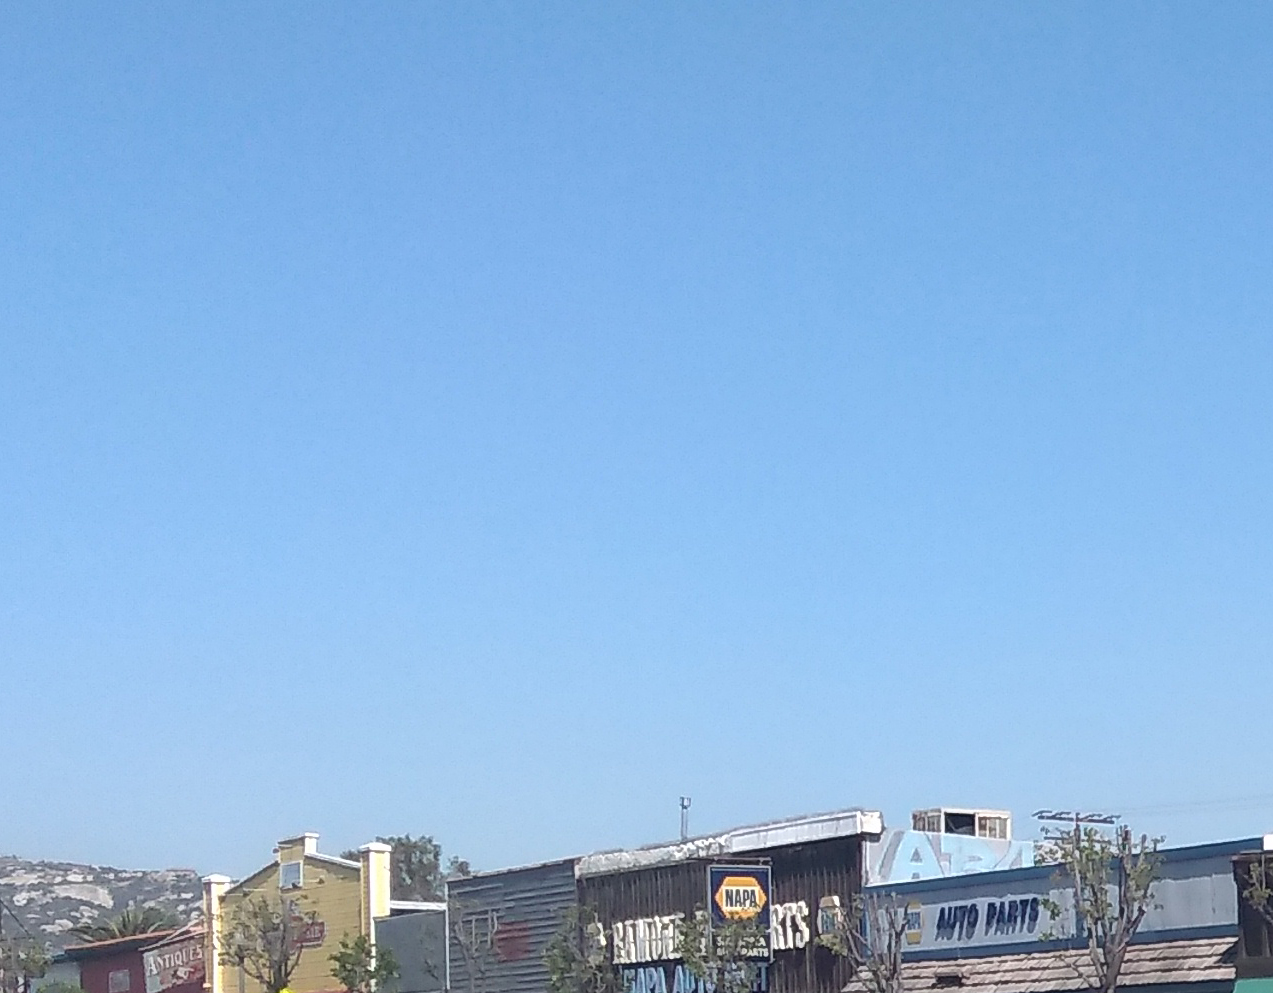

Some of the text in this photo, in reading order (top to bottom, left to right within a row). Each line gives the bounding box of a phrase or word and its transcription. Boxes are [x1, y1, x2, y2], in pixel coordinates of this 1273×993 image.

[725, 889, 757, 907] NAPA
[935, 903, 979, 940] AUTO
[984, 897, 1040, 936] PARTS
[146, 945, 203, 976] ANTIQUES
